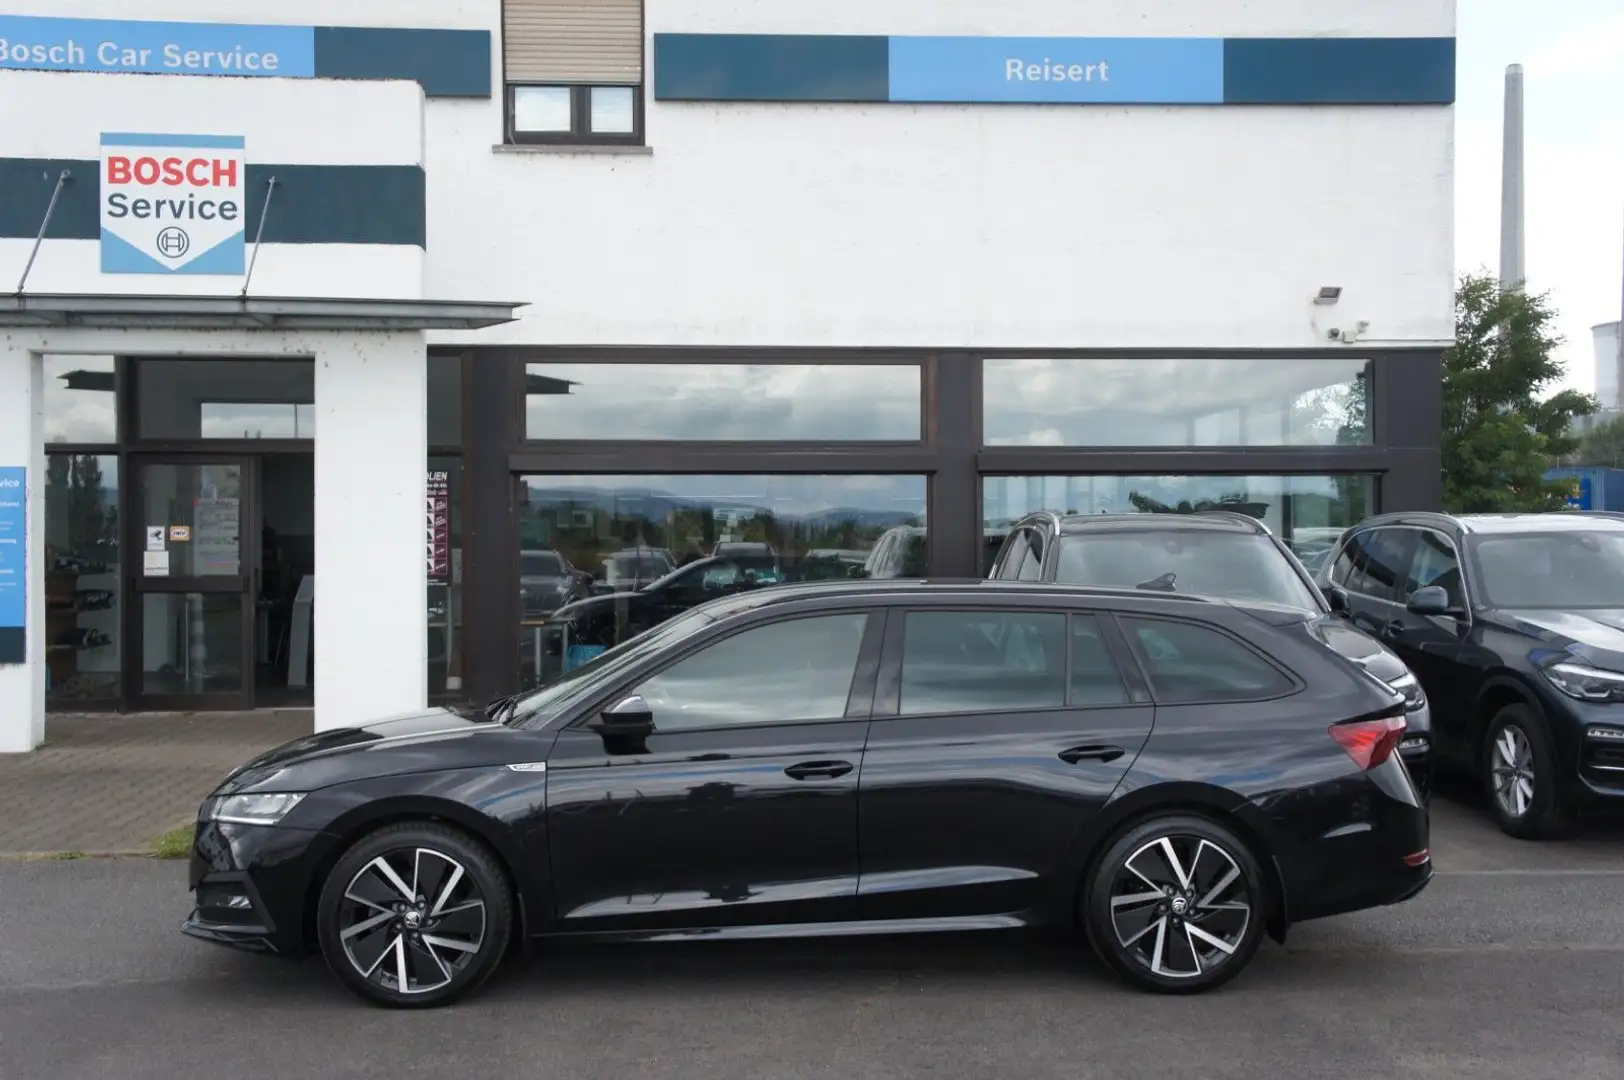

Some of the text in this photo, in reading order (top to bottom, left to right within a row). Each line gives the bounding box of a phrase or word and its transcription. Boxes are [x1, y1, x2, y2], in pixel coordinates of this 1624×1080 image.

[0, 38, 279, 70] Bosch Car Service
[1005, 57, 1109, 81] Reisert
[107, 156, 237, 187] BOSCH
[107, 192, 238, 220] Service
